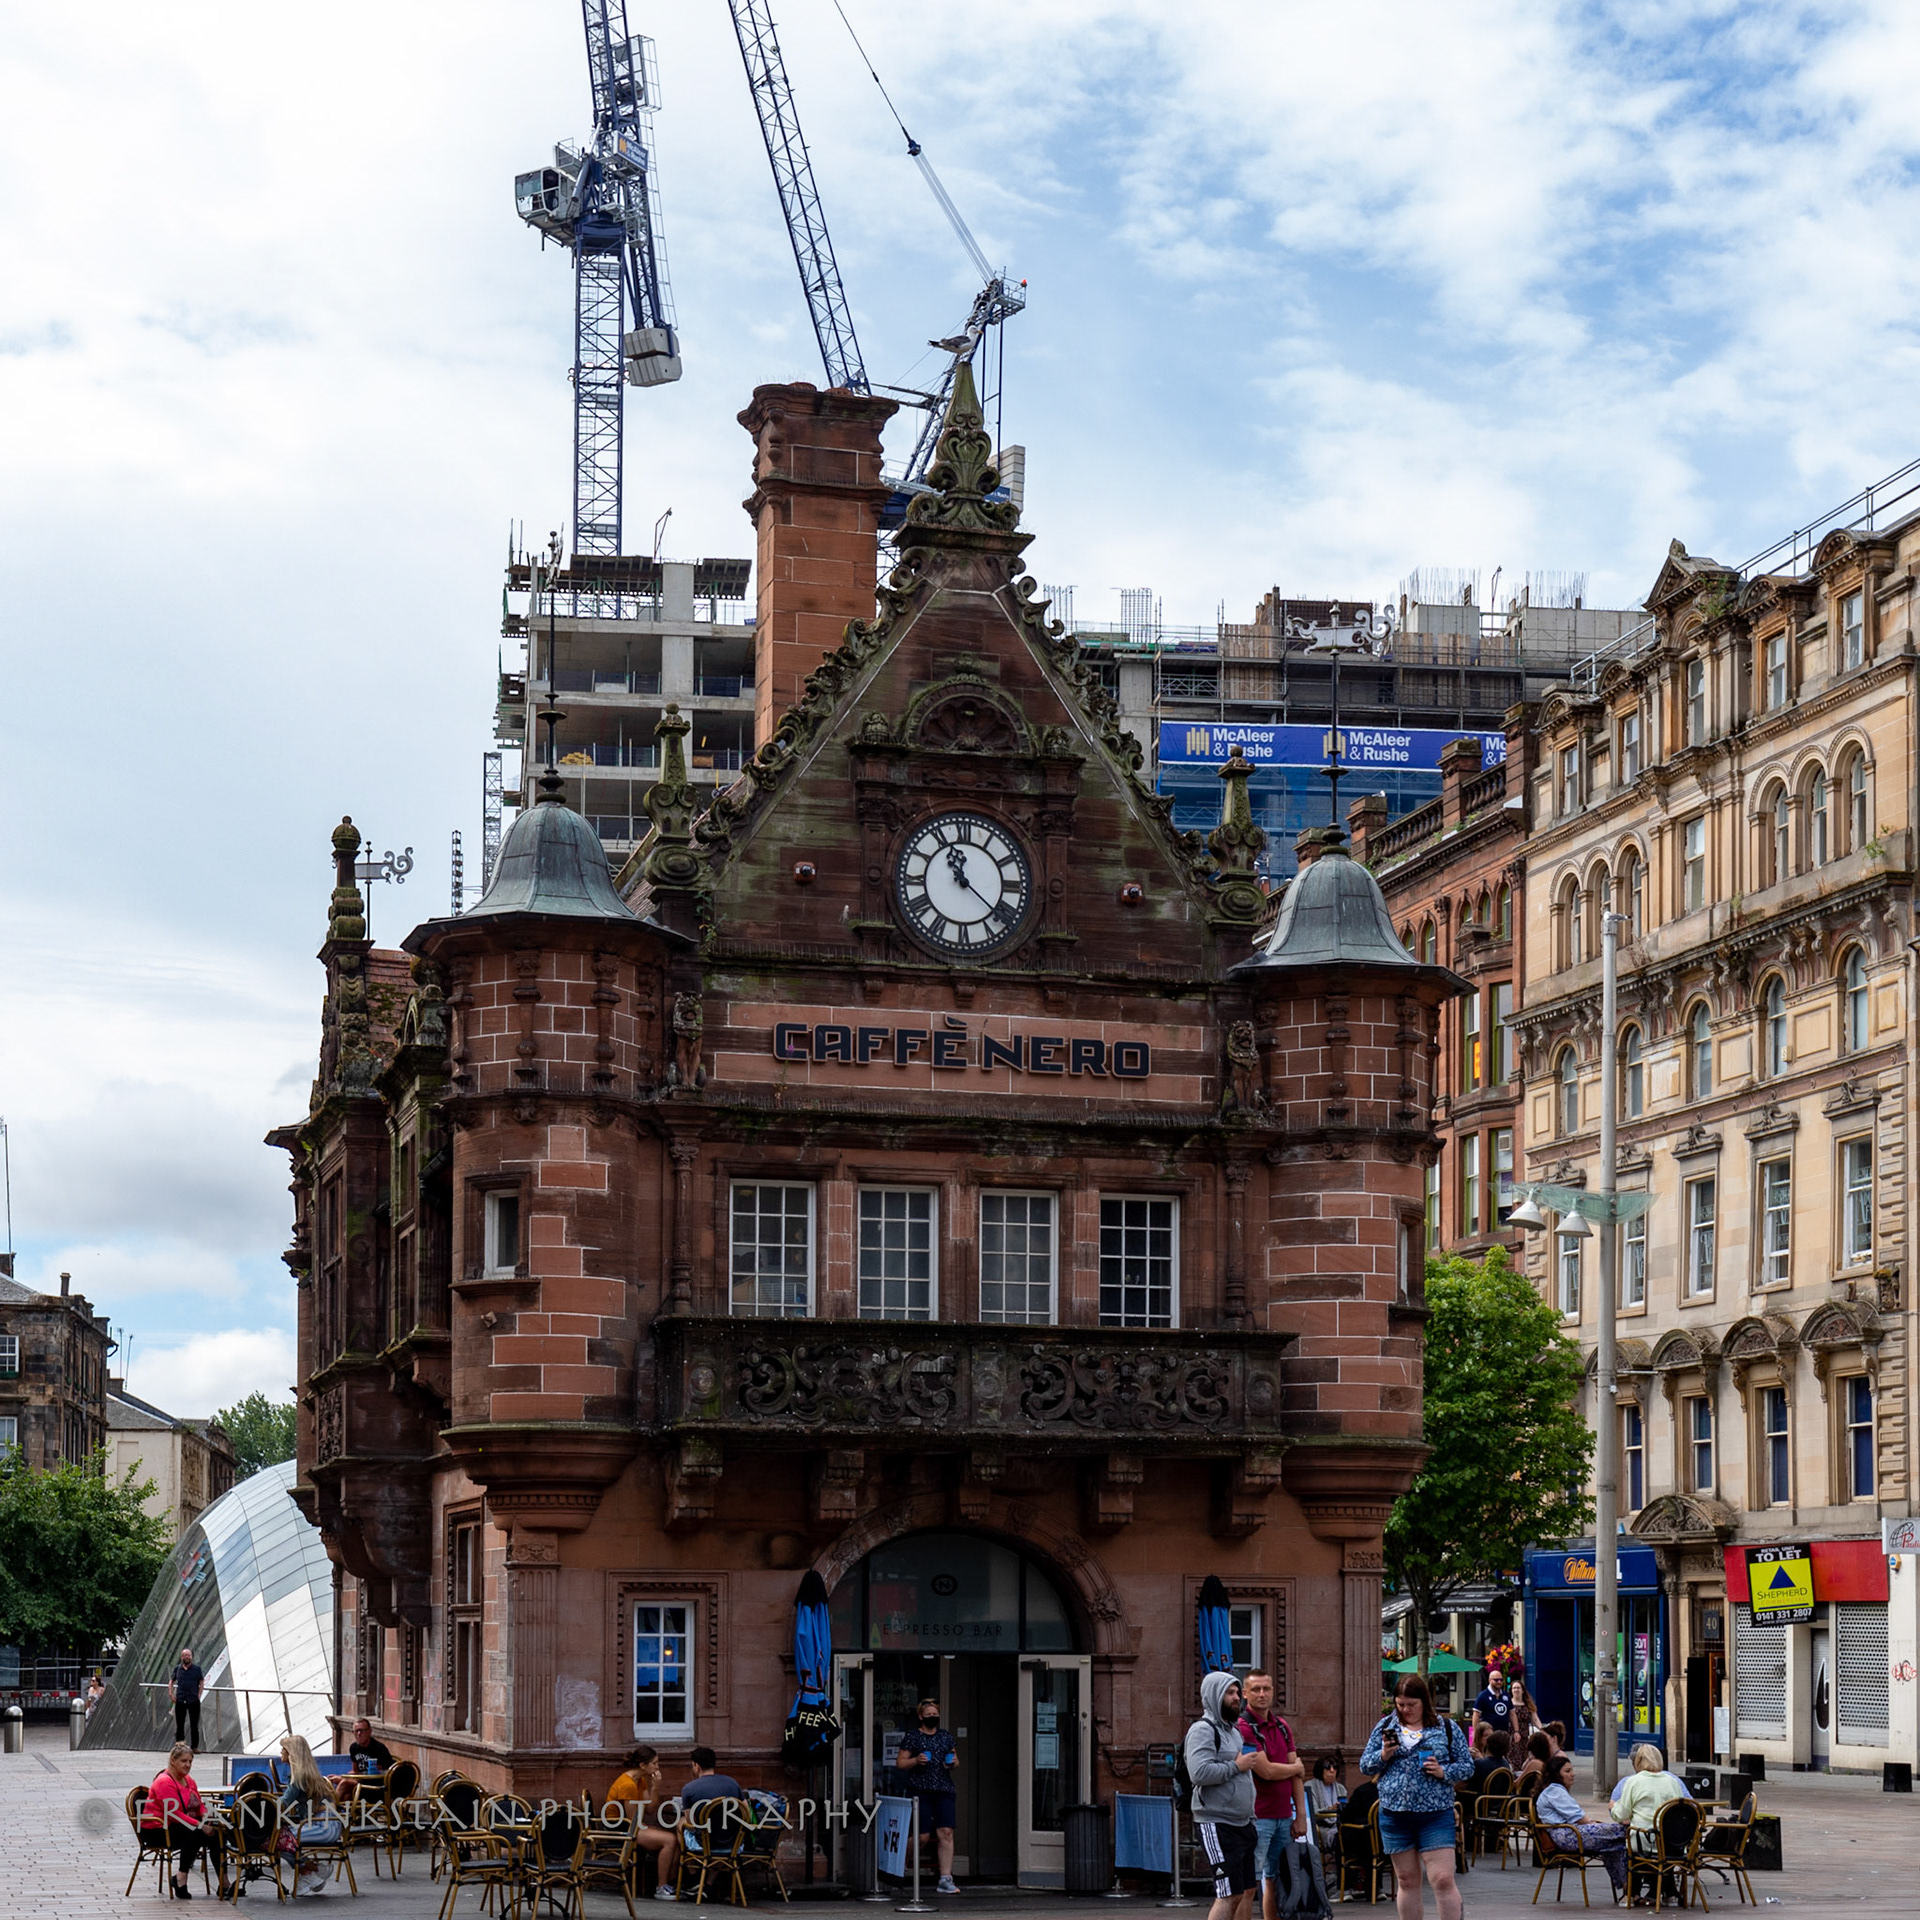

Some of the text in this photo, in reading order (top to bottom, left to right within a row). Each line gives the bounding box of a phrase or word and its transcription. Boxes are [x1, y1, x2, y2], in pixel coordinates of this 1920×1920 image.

[1213, 727, 1275, 743] McAleer
[1350, 732, 1411, 747] McAleer
[1213, 743, 1225, 757] &
[1350, 746, 1409, 762] & Rushe
[1485, 752, 1497, 766] &
[773, 1015, 1152, 1079] CAFFÈ NERO
[1755, 1549, 1802, 1563] TO LET
[1757, 1587, 1808, 1600] SHEPHERD
[1756, 1608, 1812, 1621] 0141 331 2807
[883, 1624, 1003, 1636] ESPRESSO BAR
[1706, 1617, 1717, 1630] 40
